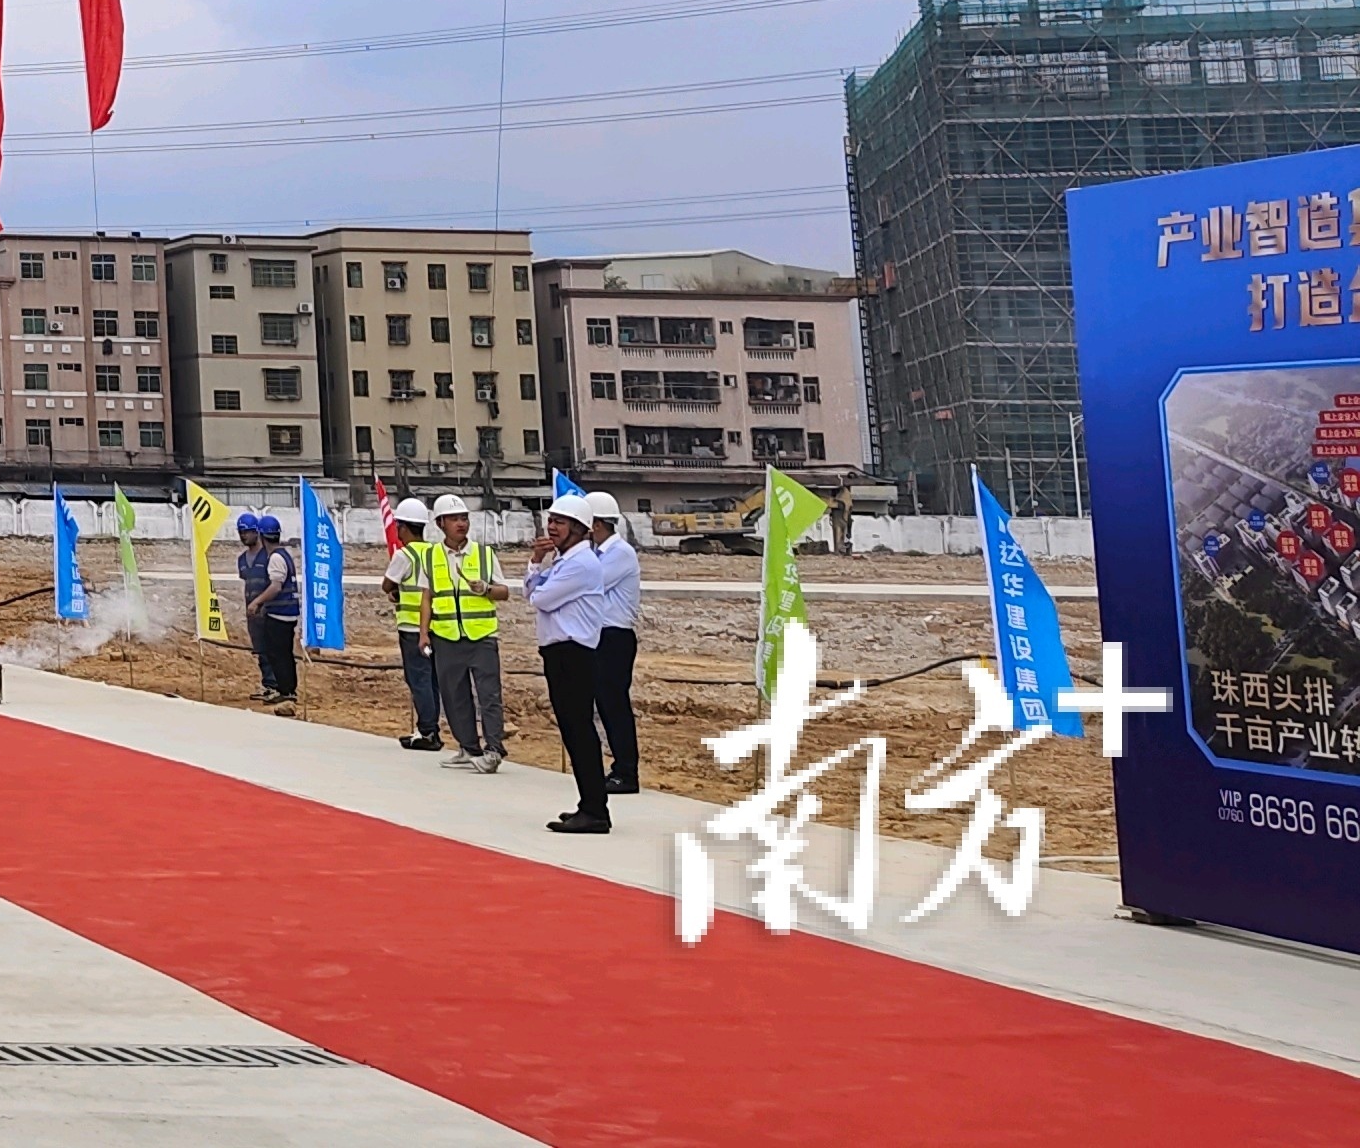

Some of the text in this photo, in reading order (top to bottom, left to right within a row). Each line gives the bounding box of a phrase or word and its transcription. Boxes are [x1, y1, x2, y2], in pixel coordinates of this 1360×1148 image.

[314, 523, 331, 640] 达华建设集团
[999, 540, 1048, 721] 达华建设集团
[1211, 669, 1336, 716] 珠西头排
[1219, 789, 1242, 807] VIP
[1249, 793, 1316, 835] 8636
